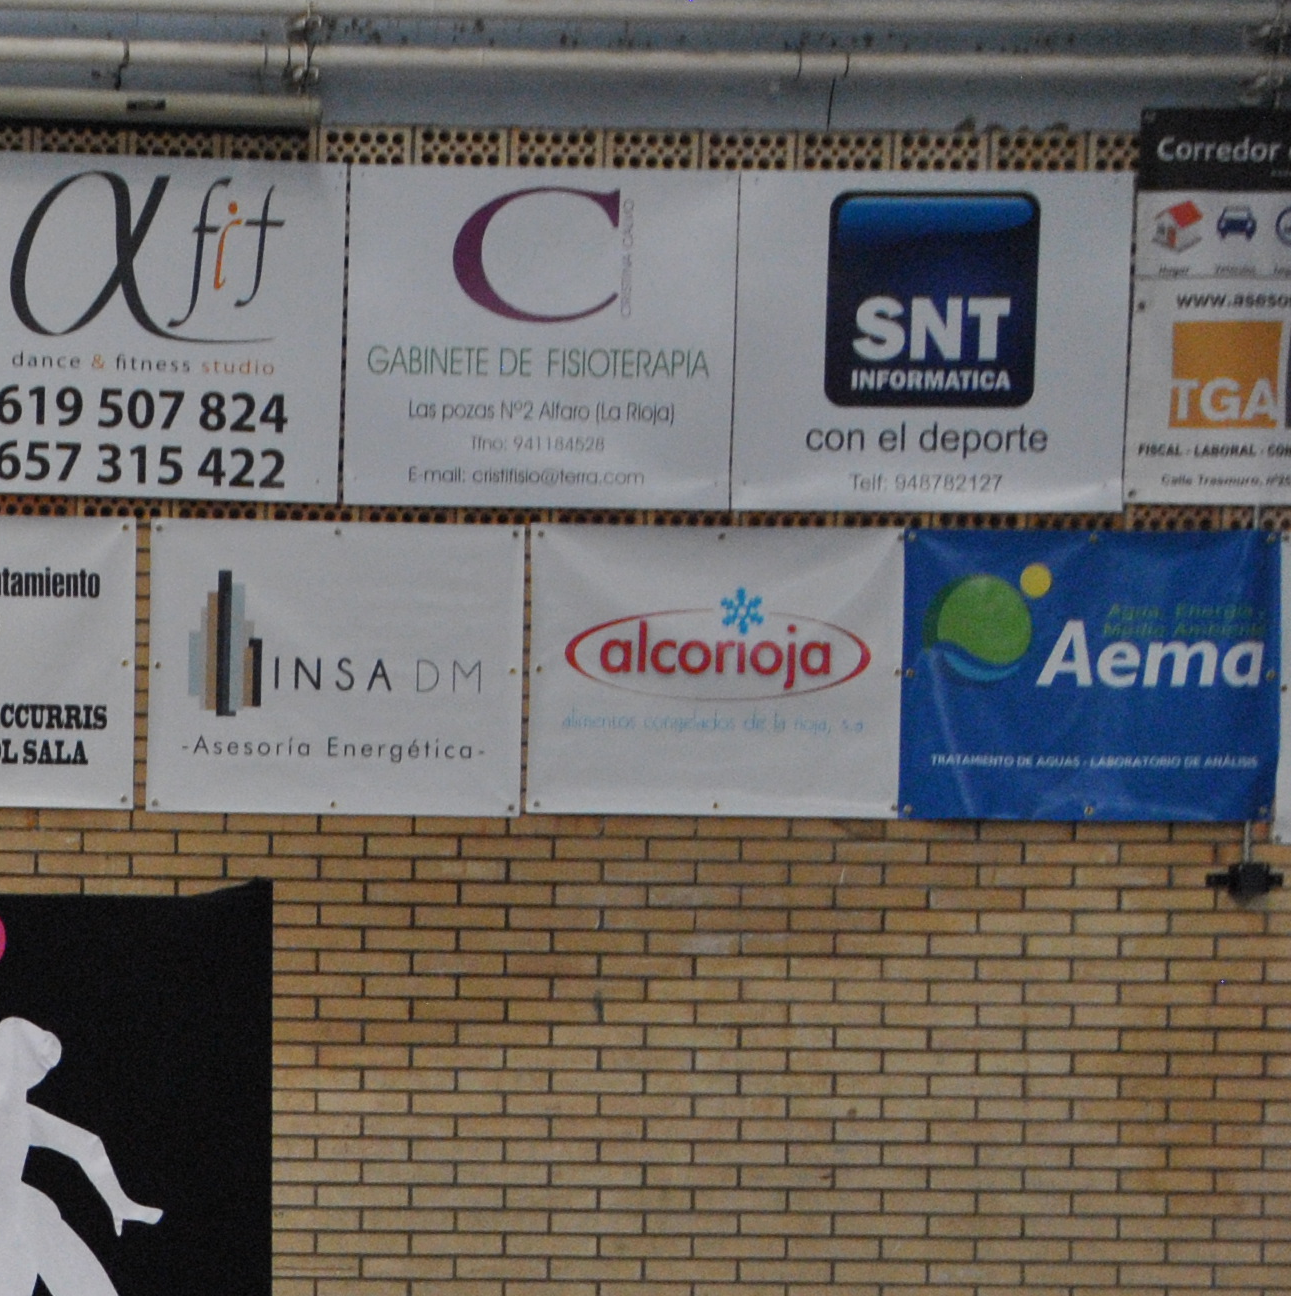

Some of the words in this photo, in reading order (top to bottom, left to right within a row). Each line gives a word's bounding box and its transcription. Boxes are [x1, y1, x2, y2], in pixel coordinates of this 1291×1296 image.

[1156, 135, 1282, 163] Corredor
[452, 186, 621, 324] C
[852, 295, 1011, 362] SNT
[12, 350, 82, 370] dance
[90, 354, 106, 370] &
[115, 353, 191, 374] fitness
[202, 358, 276, 376] studio
[367, 345, 489, 377] GABINETE
[499, 347, 533, 378] DE
[547, 347, 710, 380] FISIOTERAPIA
[850, 368, 1012, 393] INFORMATICA
[97, 387, 186, 430] 507
[198, 391, 289, 433] 824
[408, 400, 437, 421] Las
[442, 403, 495, 424] pozas
[539, 402, 591, 423] Alfaro
[595, 403, 621, 426] (La
[626, 403, 676, 427] Rioja)
[1172, 377, 1278, 422] TGA
[805, 426, 866, 452] con
[878, 421, 907, 451] el
[918, 421, 1049, 460] deporte
[96, 443, 184, 485] 315
[197, 446, 287, 489] 422
[599, 619, 832, 691] alcorioja
[1035, 618, 1266, 688] Aema
[274, 656, 393, 692] INSA
[416, 659, 482, 694] DM
[21, 740, 89, 766] SALA
[1036, 755, 1081, 768] AGUAS
